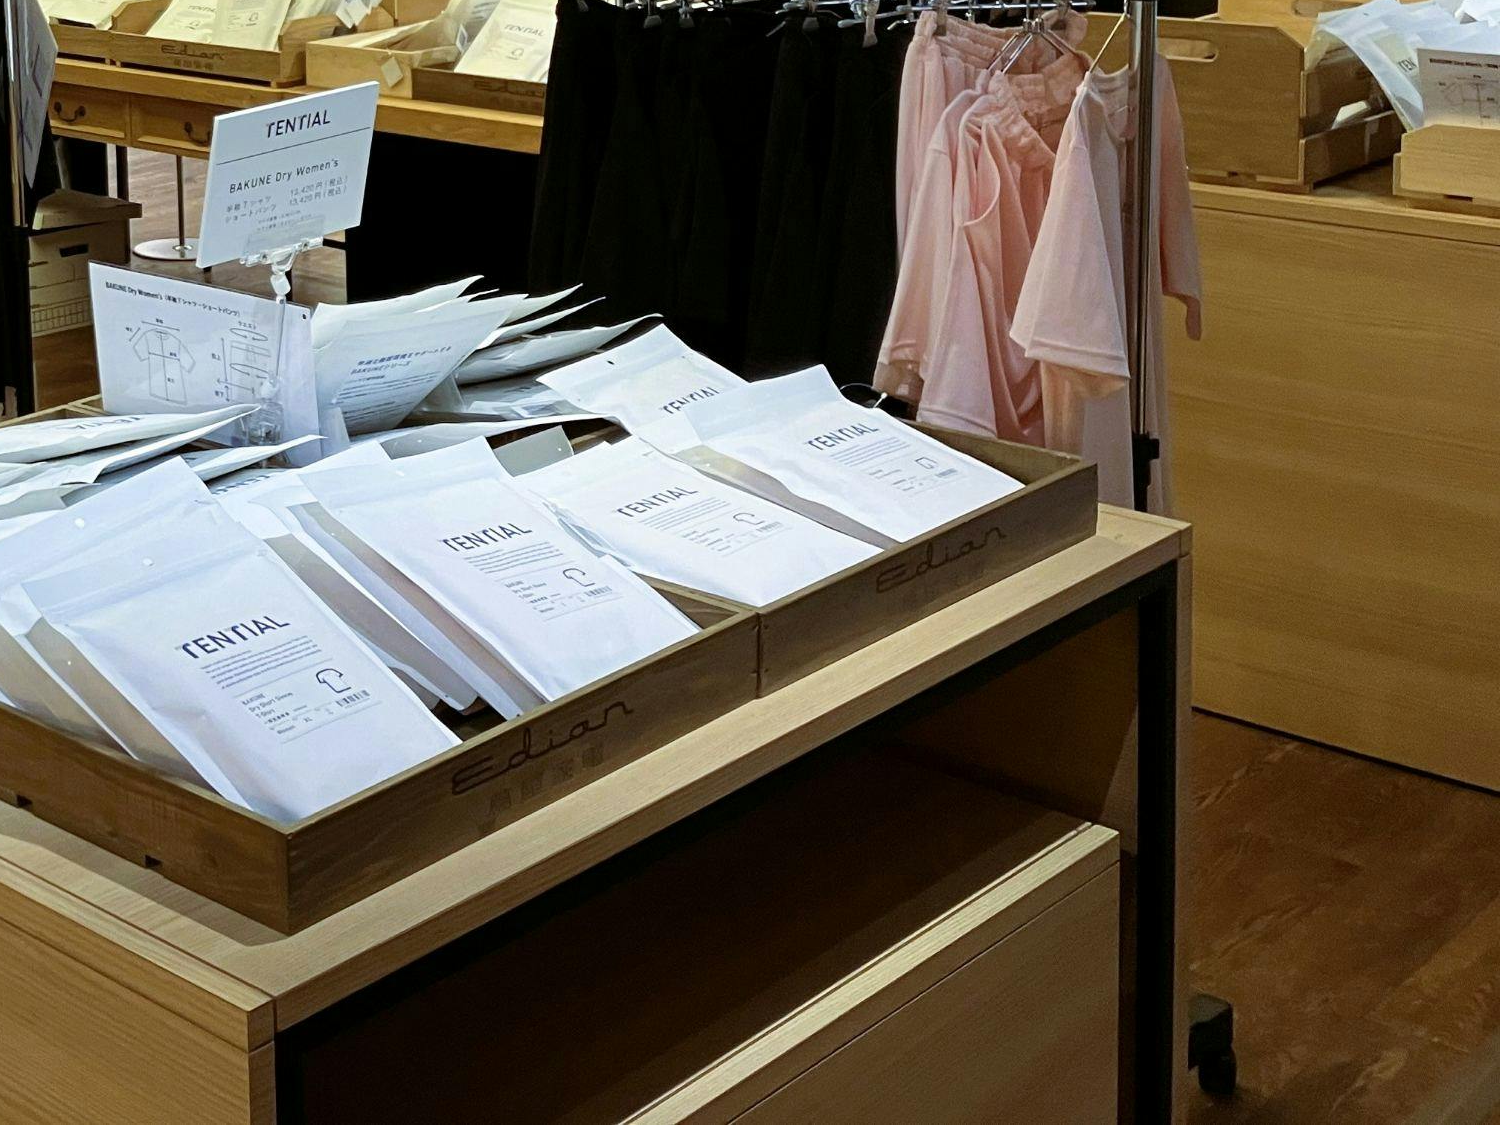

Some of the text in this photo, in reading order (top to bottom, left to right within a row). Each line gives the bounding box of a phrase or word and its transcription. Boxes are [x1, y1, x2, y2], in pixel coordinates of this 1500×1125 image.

[265, 109, 332, 139] TENTIAL
[229, 158, 339, 194] BAKUNE Dry Women's
[804, 423, 880, 451] TENTIAL
[612, 487, 699, 518] TENTIAL
[438, 522, 533, 552] TENTIAL
[174, 616, 291, 659] TENTIAL
